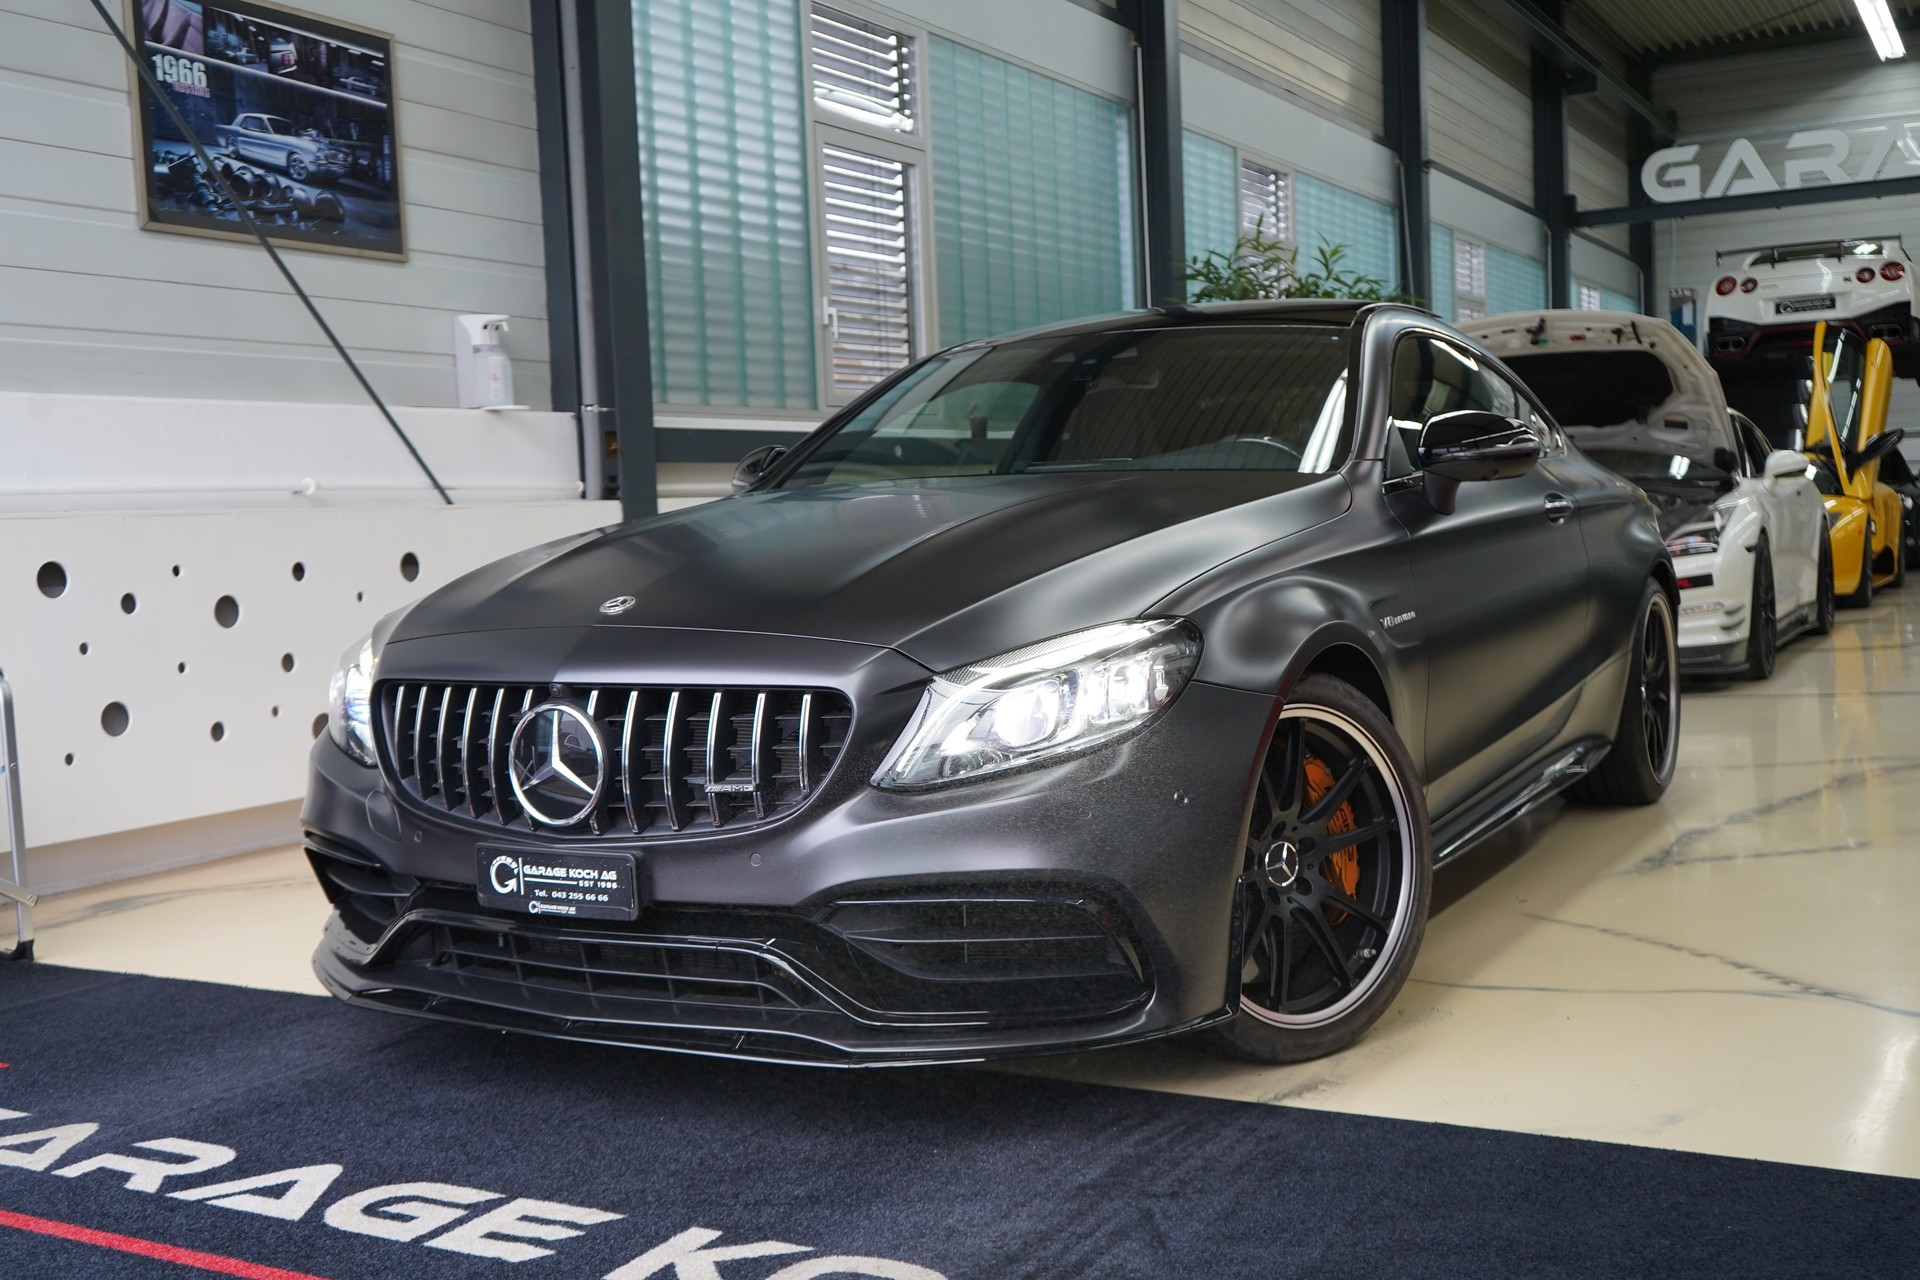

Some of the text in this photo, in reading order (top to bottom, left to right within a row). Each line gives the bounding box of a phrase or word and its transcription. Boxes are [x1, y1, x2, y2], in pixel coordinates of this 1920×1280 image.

[151, 53, 208, 88] 1966
[523, 864, 617, 880] GARAGE KOCH AG
[579, 880, 594, 888] EST
[534, 889, 548, 898] Tel.
[551, 891, 567, 899] 043
[568, 892, 584, 901] 255
